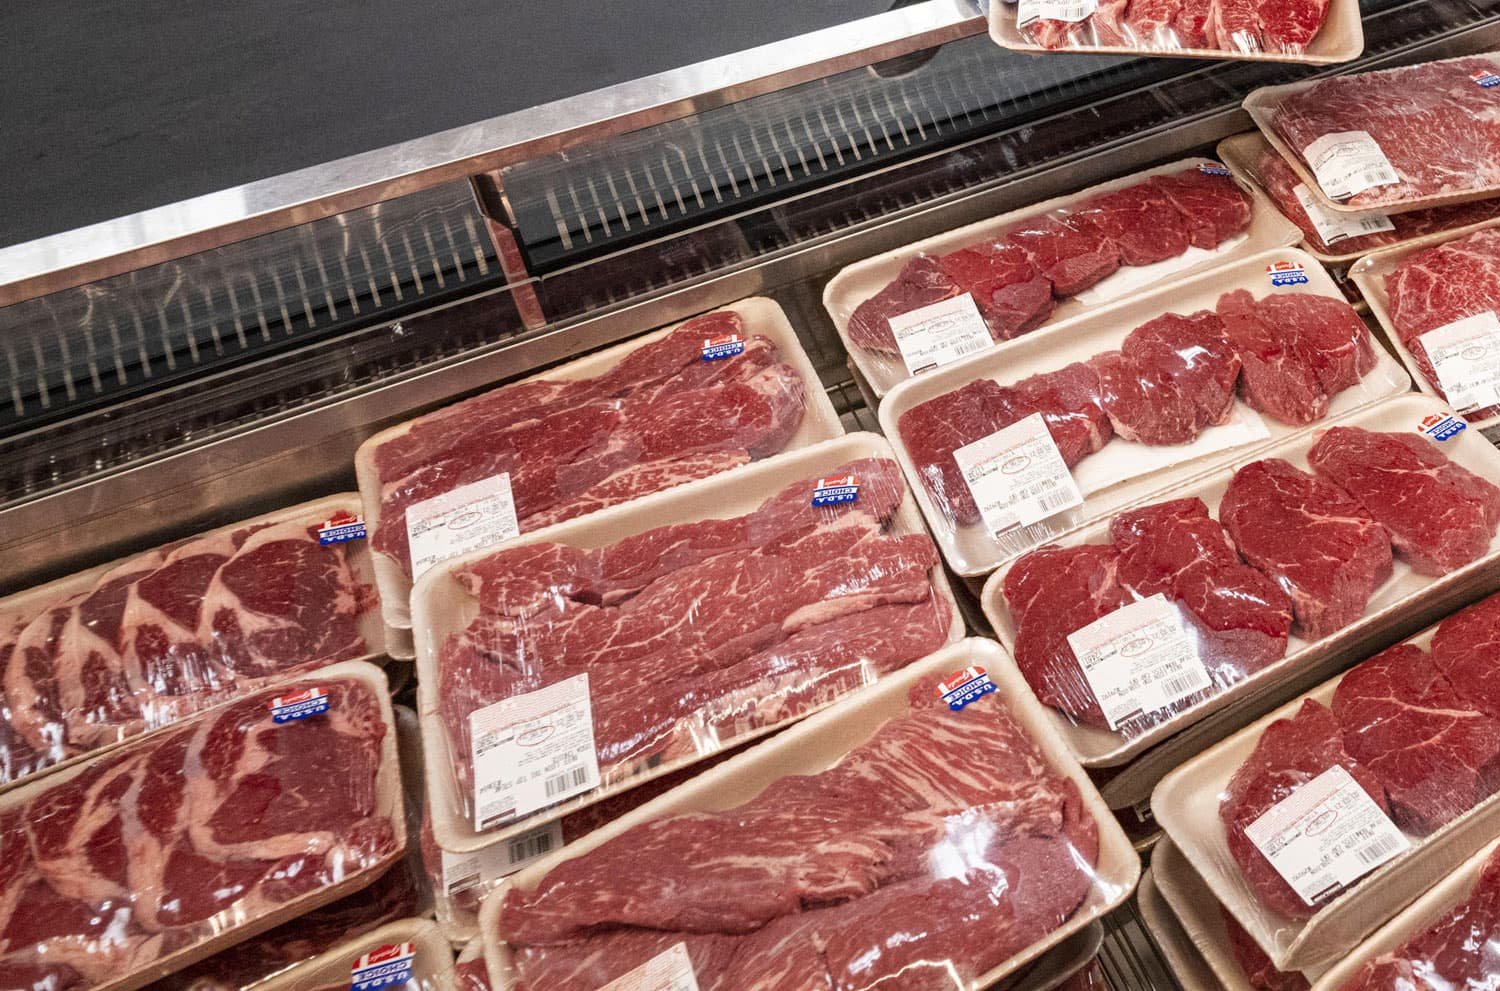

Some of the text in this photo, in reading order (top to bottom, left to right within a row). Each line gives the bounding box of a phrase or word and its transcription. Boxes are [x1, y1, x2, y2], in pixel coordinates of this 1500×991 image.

[706, 348, 741, 359] U.S.D.A.
[816, 494, 855, 504] U.S.D.A.
[819, 487, 853, 497] CHOICE
[323, 530, 366, 543] U.S.D.A.
[949, 683, 993, 706] U.S.D.A.
[950, 678, 986, 701] CHOICE
[278, 704, 325, 721] U.S.D.A.
[360, 960, 408, 982] CHOICE
[357, 971, 408, 991] U.S.D.A.
